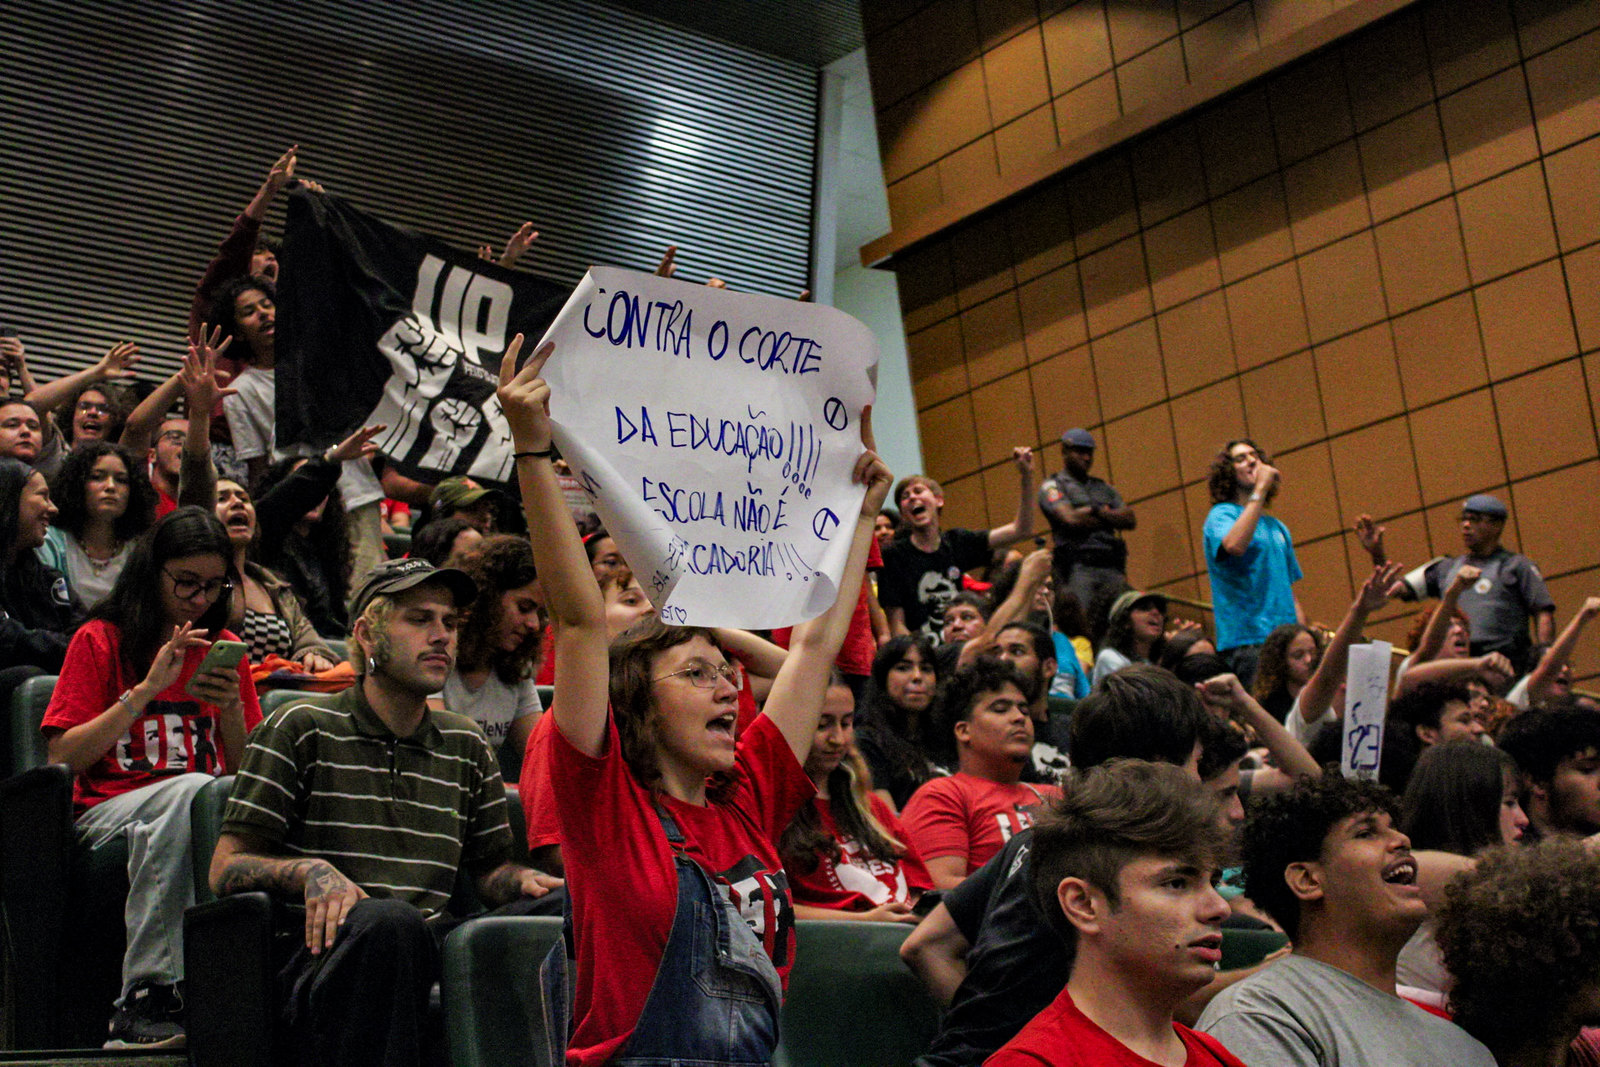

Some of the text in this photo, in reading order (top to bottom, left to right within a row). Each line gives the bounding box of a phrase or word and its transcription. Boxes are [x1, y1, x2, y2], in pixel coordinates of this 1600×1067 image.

[584, 288, 823, 374] CONTRA O CORTE
[615, 406, 658, 447] DA
[643, 476, 727, 527] ESCOLA
[734, 481, 772, 534] NÃO
[773, 486, 789, 530] É
[687, 540, 821, 581] CADORIA!!!
